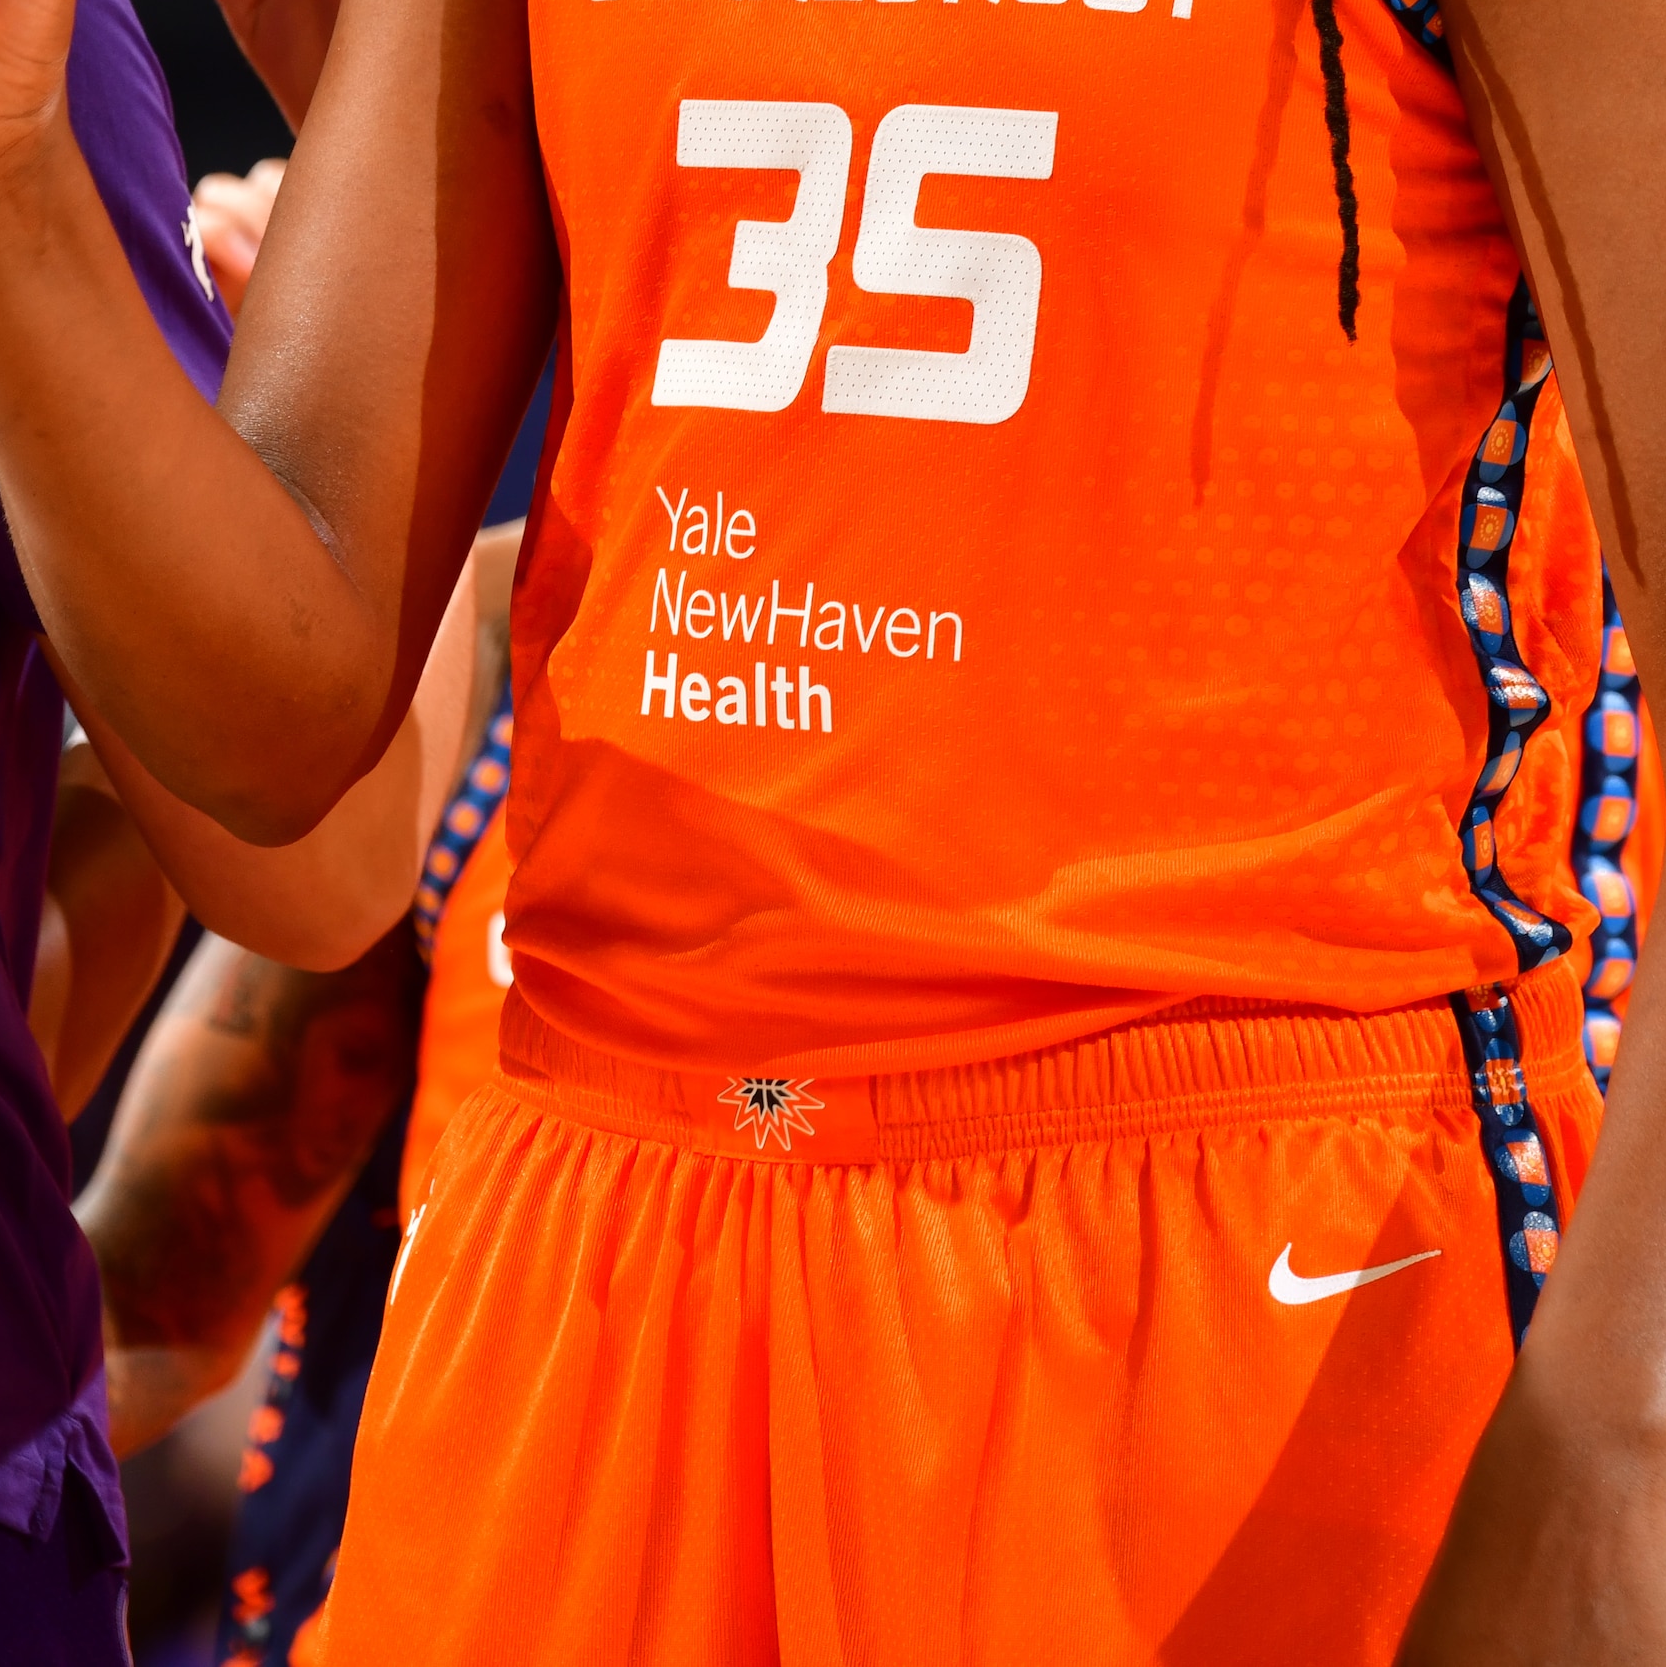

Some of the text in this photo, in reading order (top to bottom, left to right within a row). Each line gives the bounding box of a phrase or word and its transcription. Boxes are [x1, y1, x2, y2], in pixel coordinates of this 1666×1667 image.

[651, 99, 1059, 425] 35
[656, 486, 756, 559] Yale
[650, 568, 963, 662] NewHaven
[641, 650, 832, 733] Health
